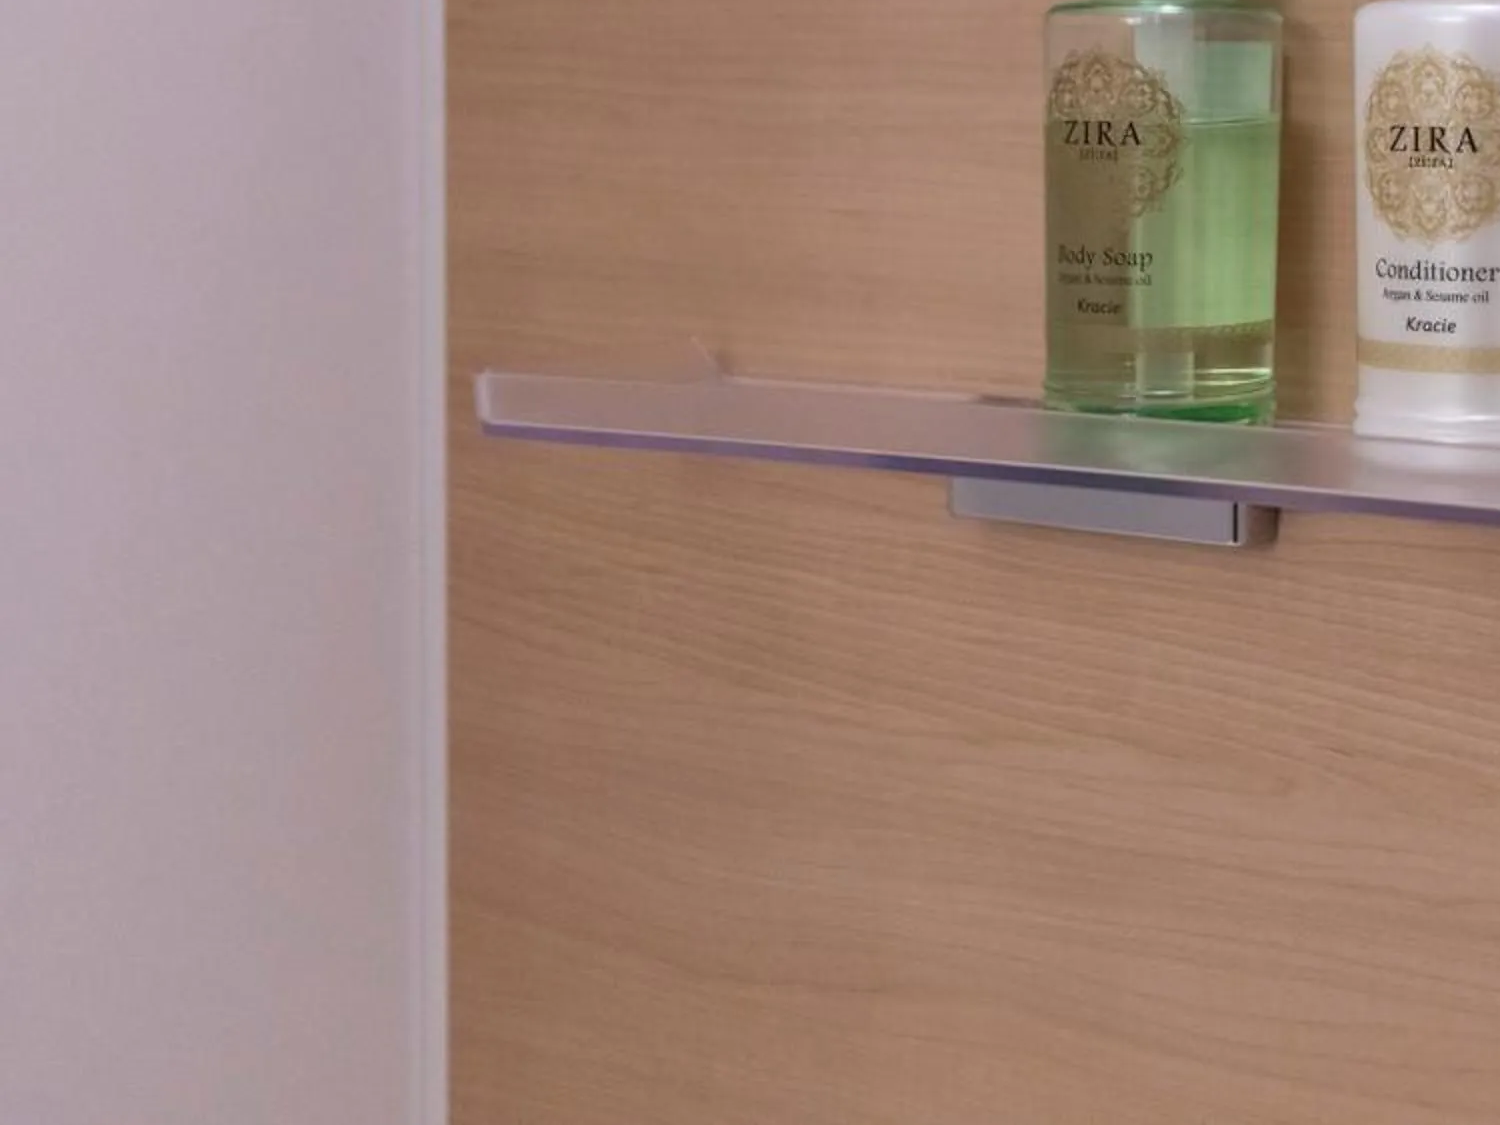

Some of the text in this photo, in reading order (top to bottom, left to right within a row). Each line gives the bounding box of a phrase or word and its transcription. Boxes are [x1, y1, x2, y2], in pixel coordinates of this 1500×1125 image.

[1063, 120, 1142, 146] ZIRA
[1390, 125, 1478, 154] ZIRA
[1375, 258, 1500, 282] Conditioner
[1406, 316, 1456, 333] Kracie
